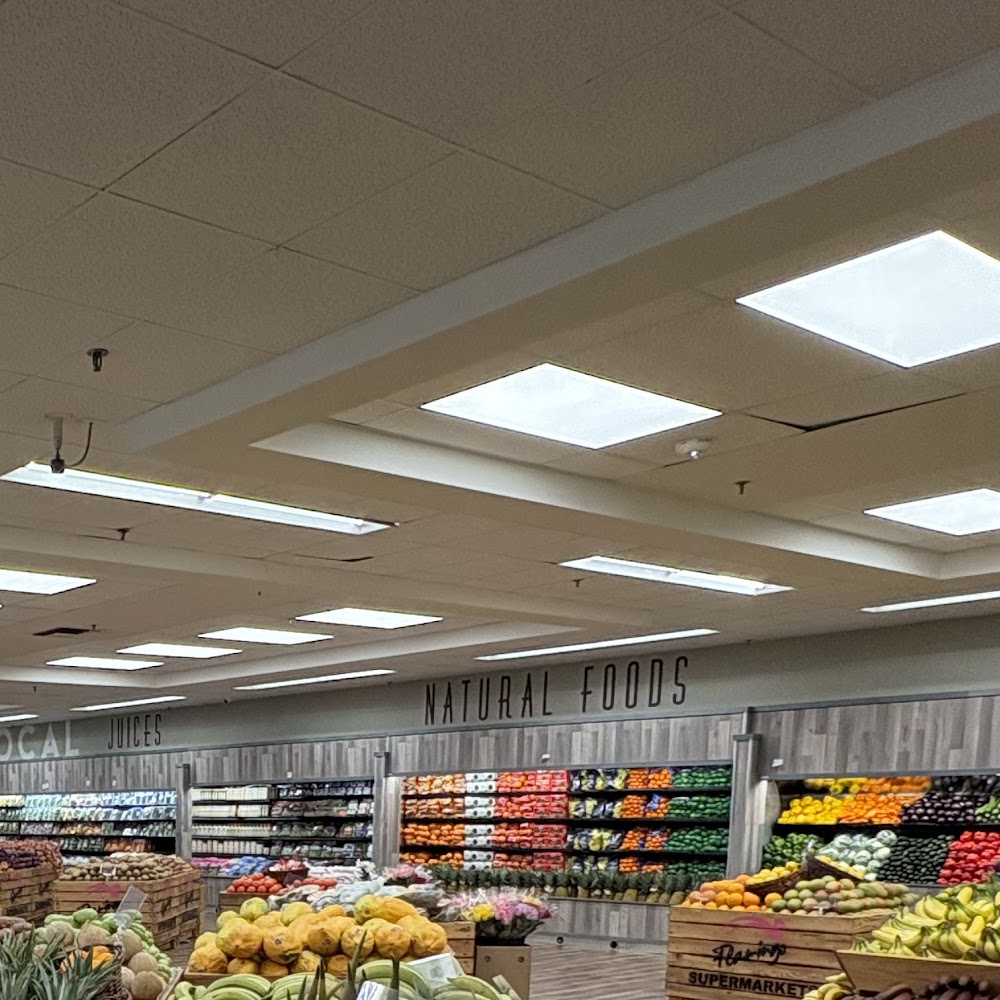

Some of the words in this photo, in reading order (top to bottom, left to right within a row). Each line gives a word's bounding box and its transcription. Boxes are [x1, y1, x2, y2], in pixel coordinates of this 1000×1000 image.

[425, 671, 553, 725] NATURAL
[581, 656, 689, 713] FOODS
[107, 713, 162, 749] JUICES
[711, 940, 787, 968] Flamingo
